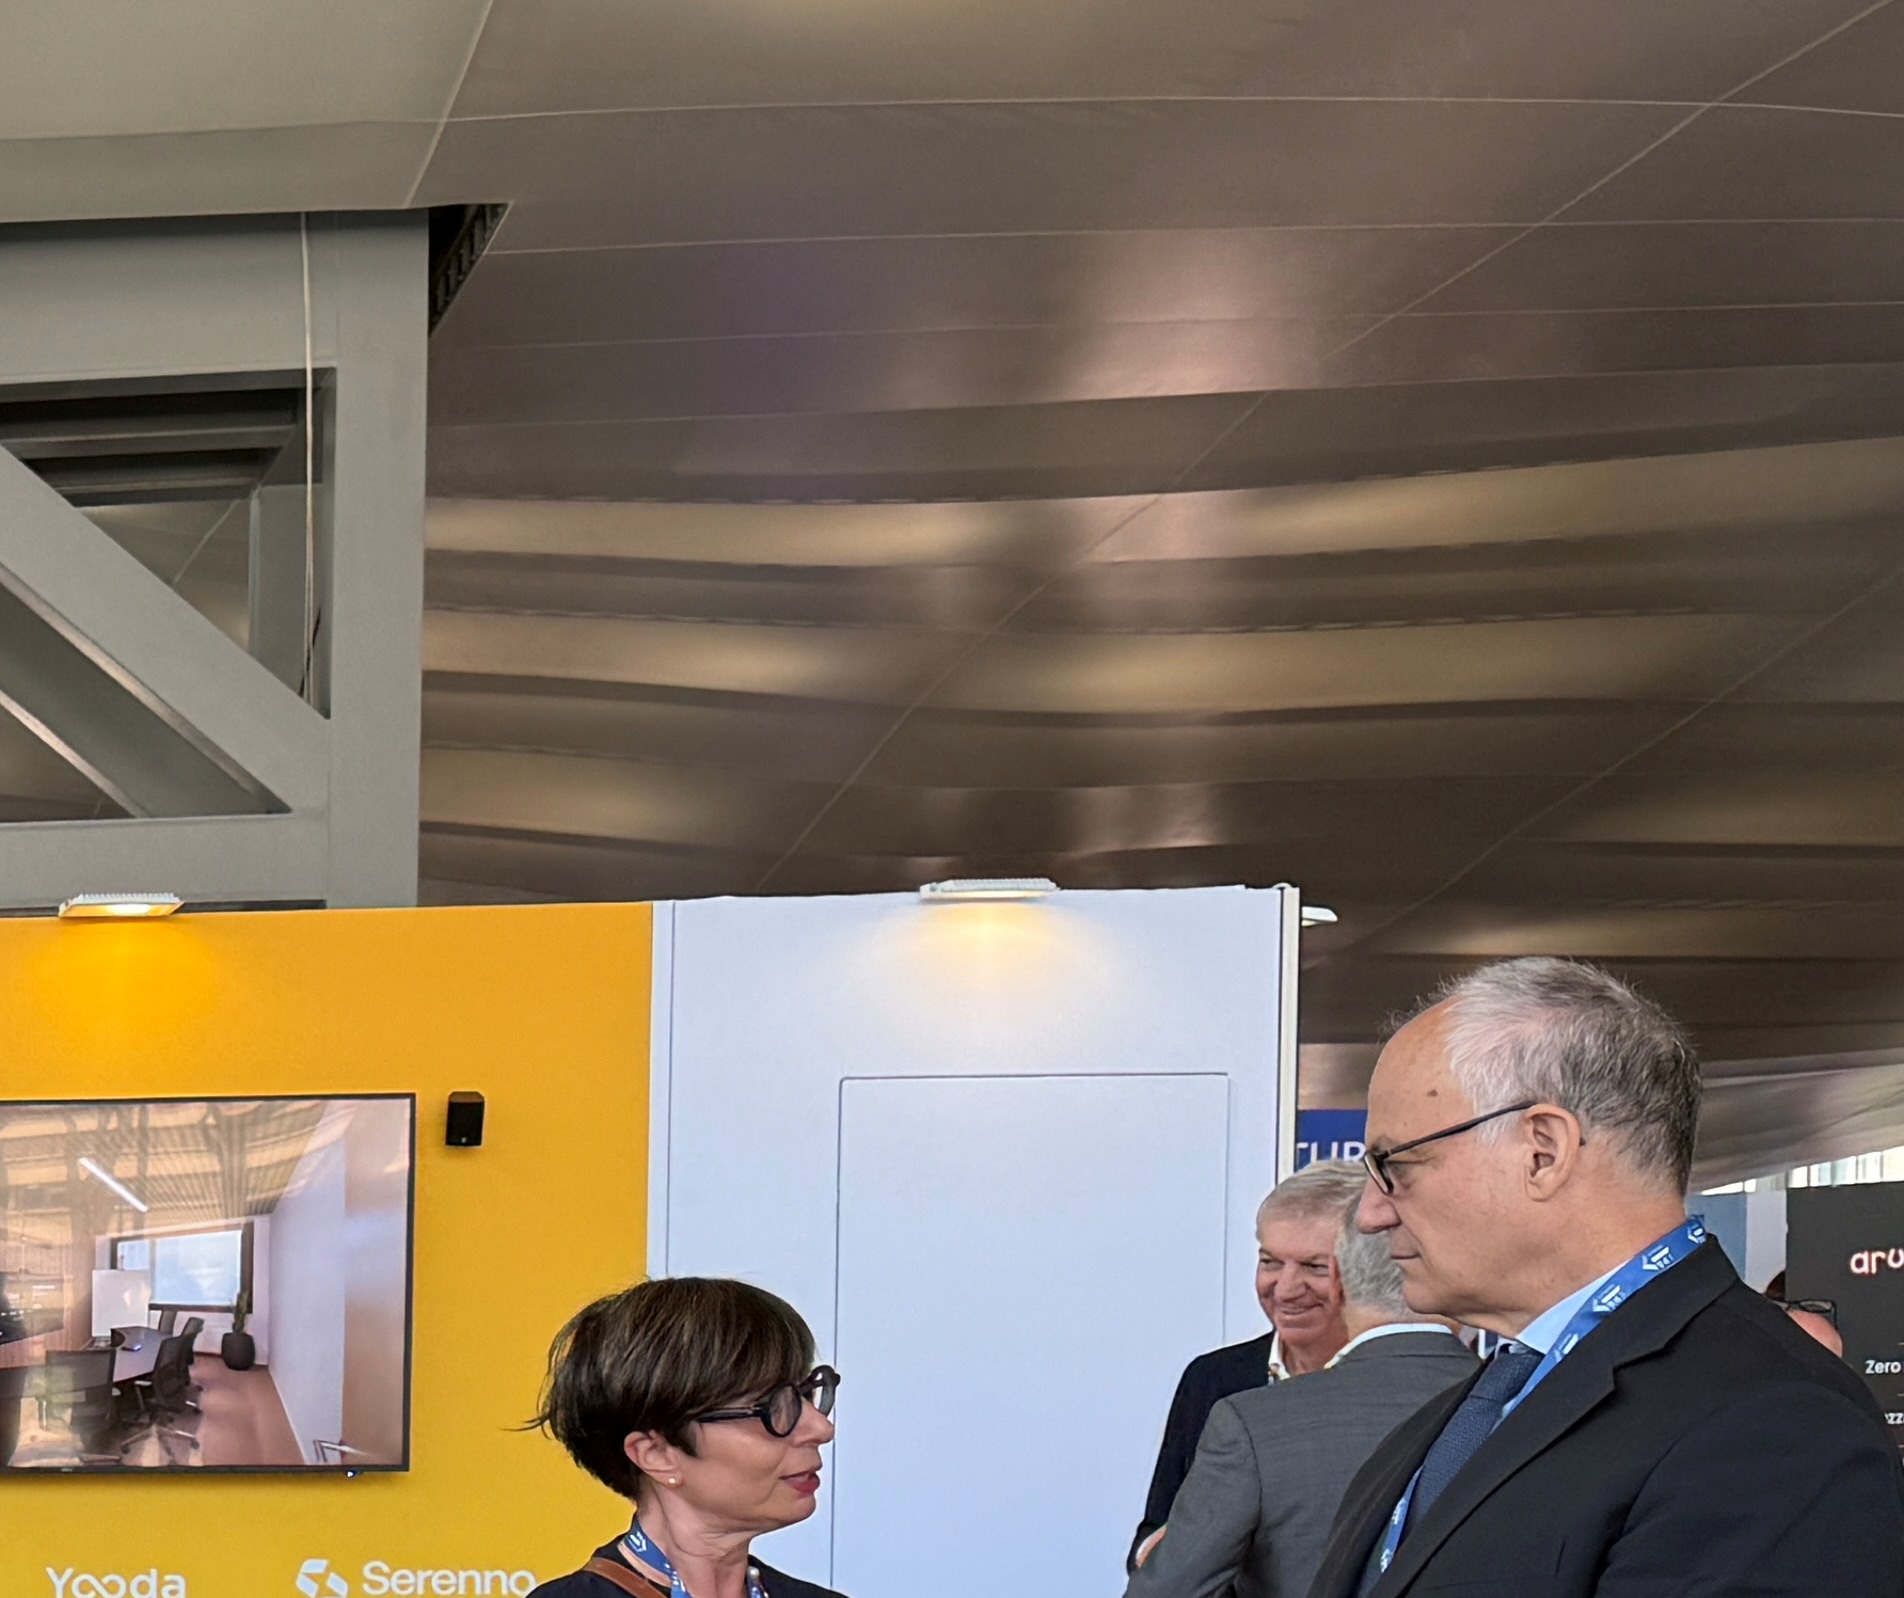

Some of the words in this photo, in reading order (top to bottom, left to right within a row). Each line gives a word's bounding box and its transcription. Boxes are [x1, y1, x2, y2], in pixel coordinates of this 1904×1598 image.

[1850, 1249, 1904, 1276] aru
[1865, 1360, 1902, 1375] Zero
[361, 1560, 538, 1597] Serenno
